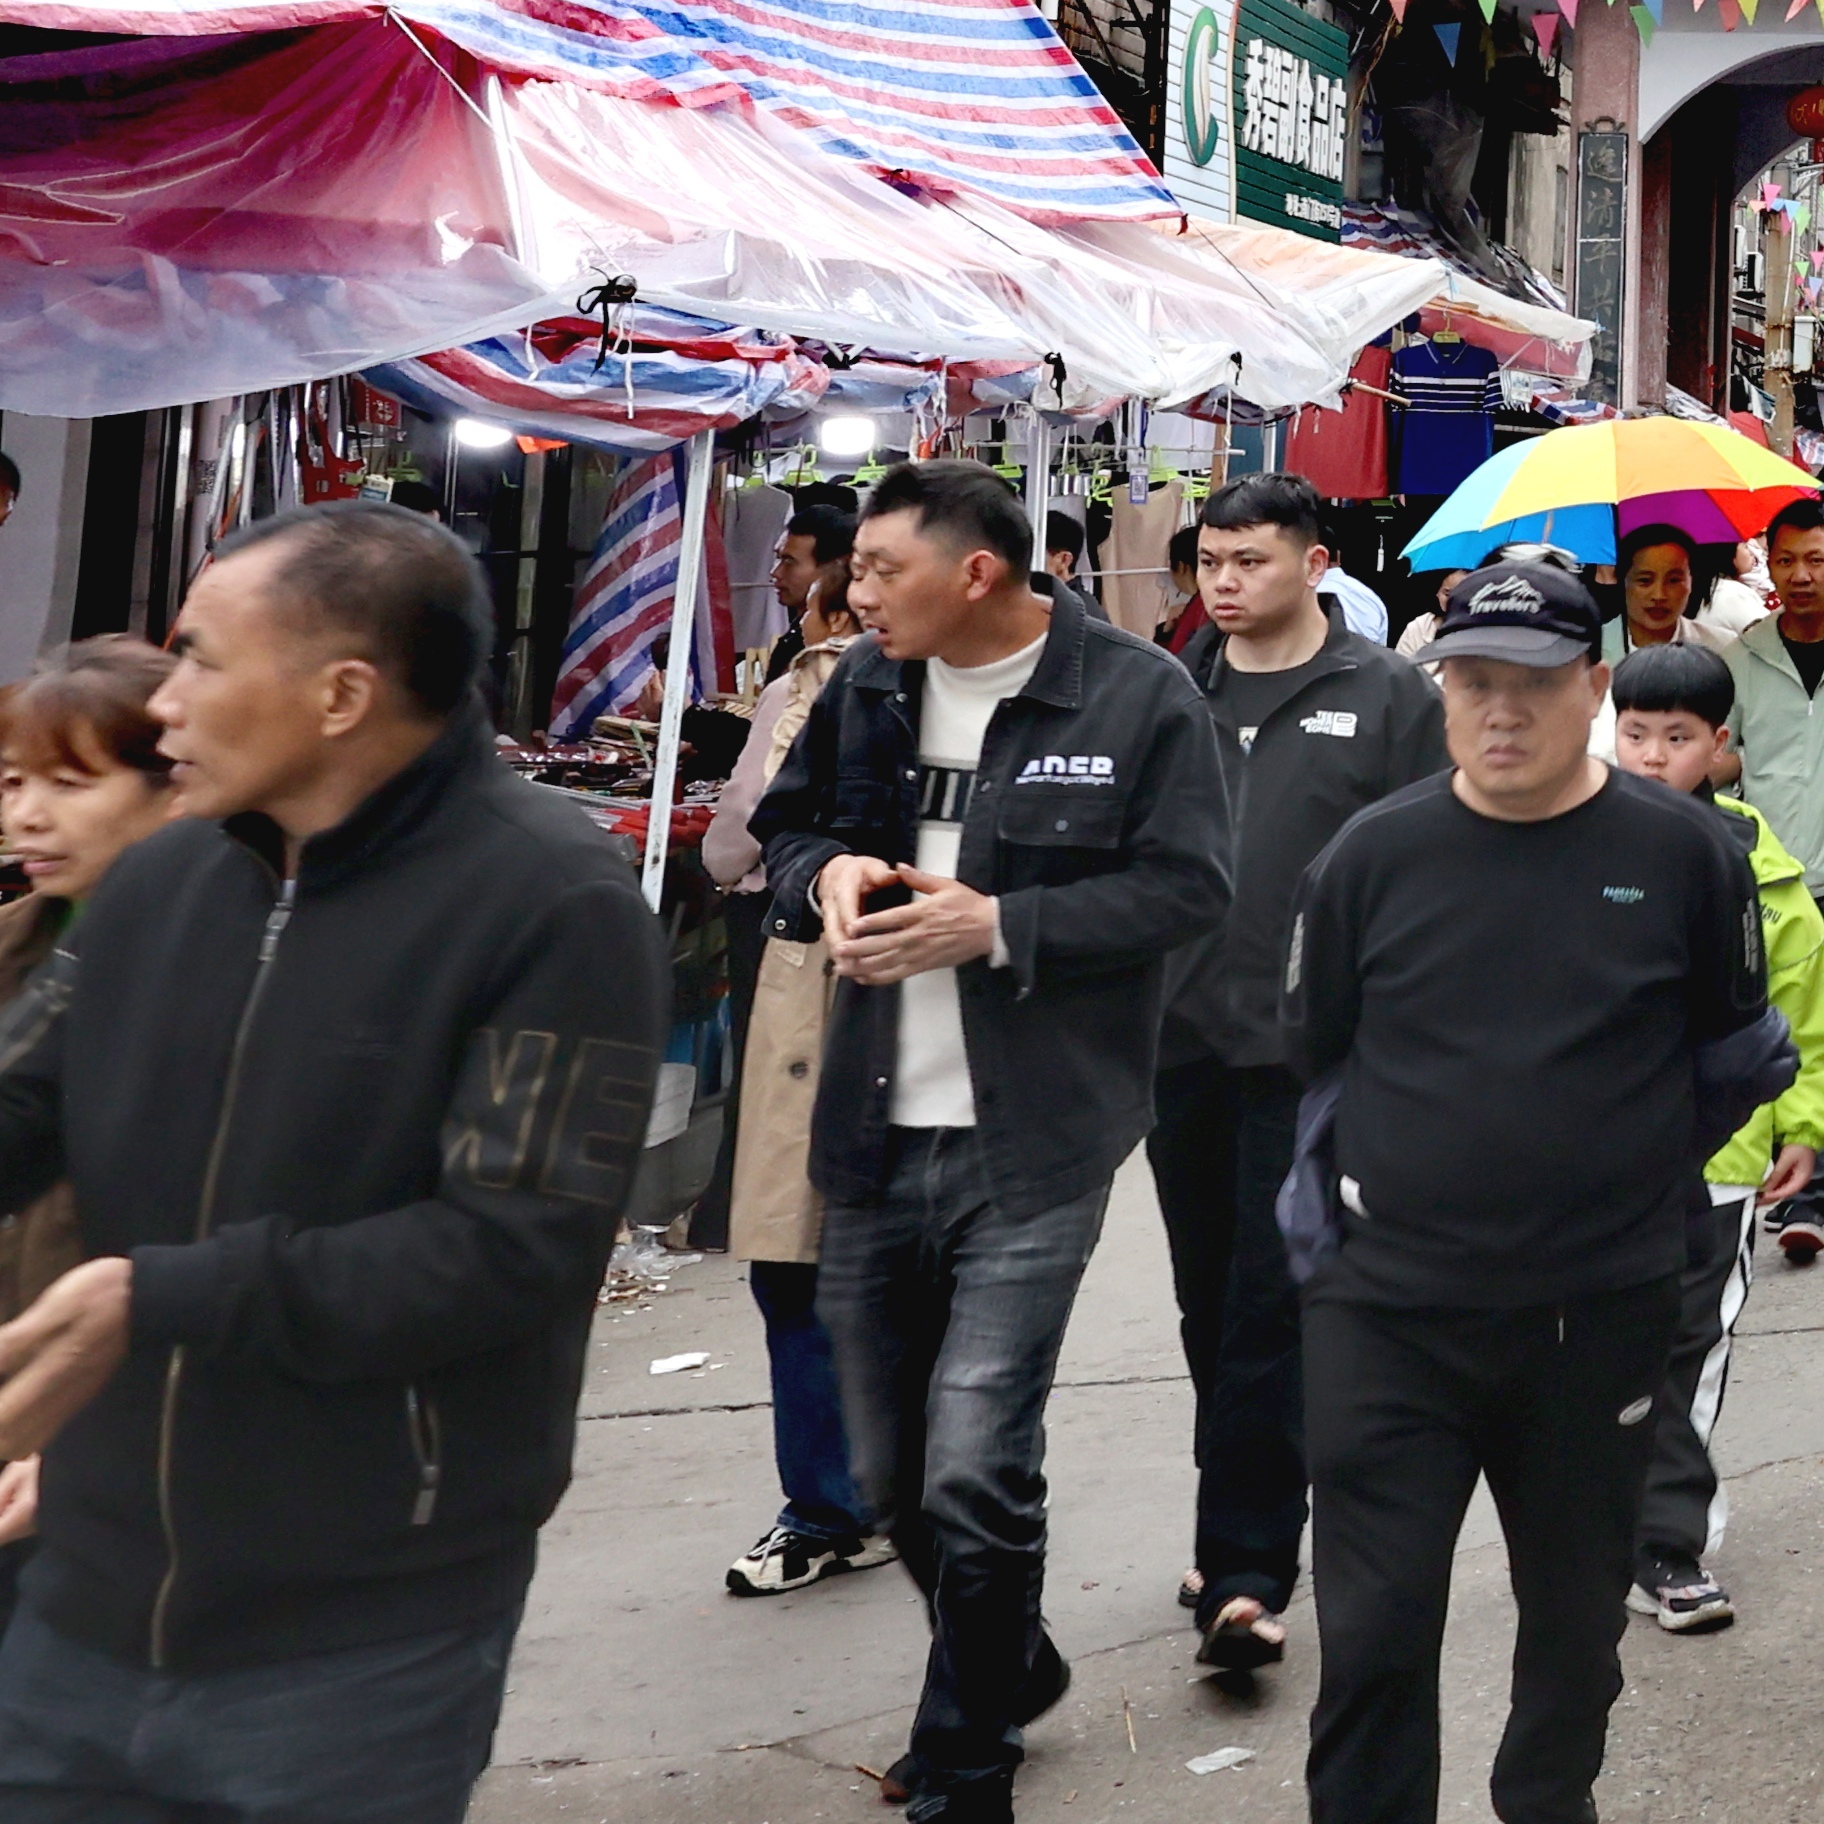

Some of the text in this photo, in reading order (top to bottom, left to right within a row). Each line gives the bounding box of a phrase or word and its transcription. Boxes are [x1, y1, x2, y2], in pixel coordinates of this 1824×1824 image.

[1241, 38, 1347, 182] 秀碧副食品店
